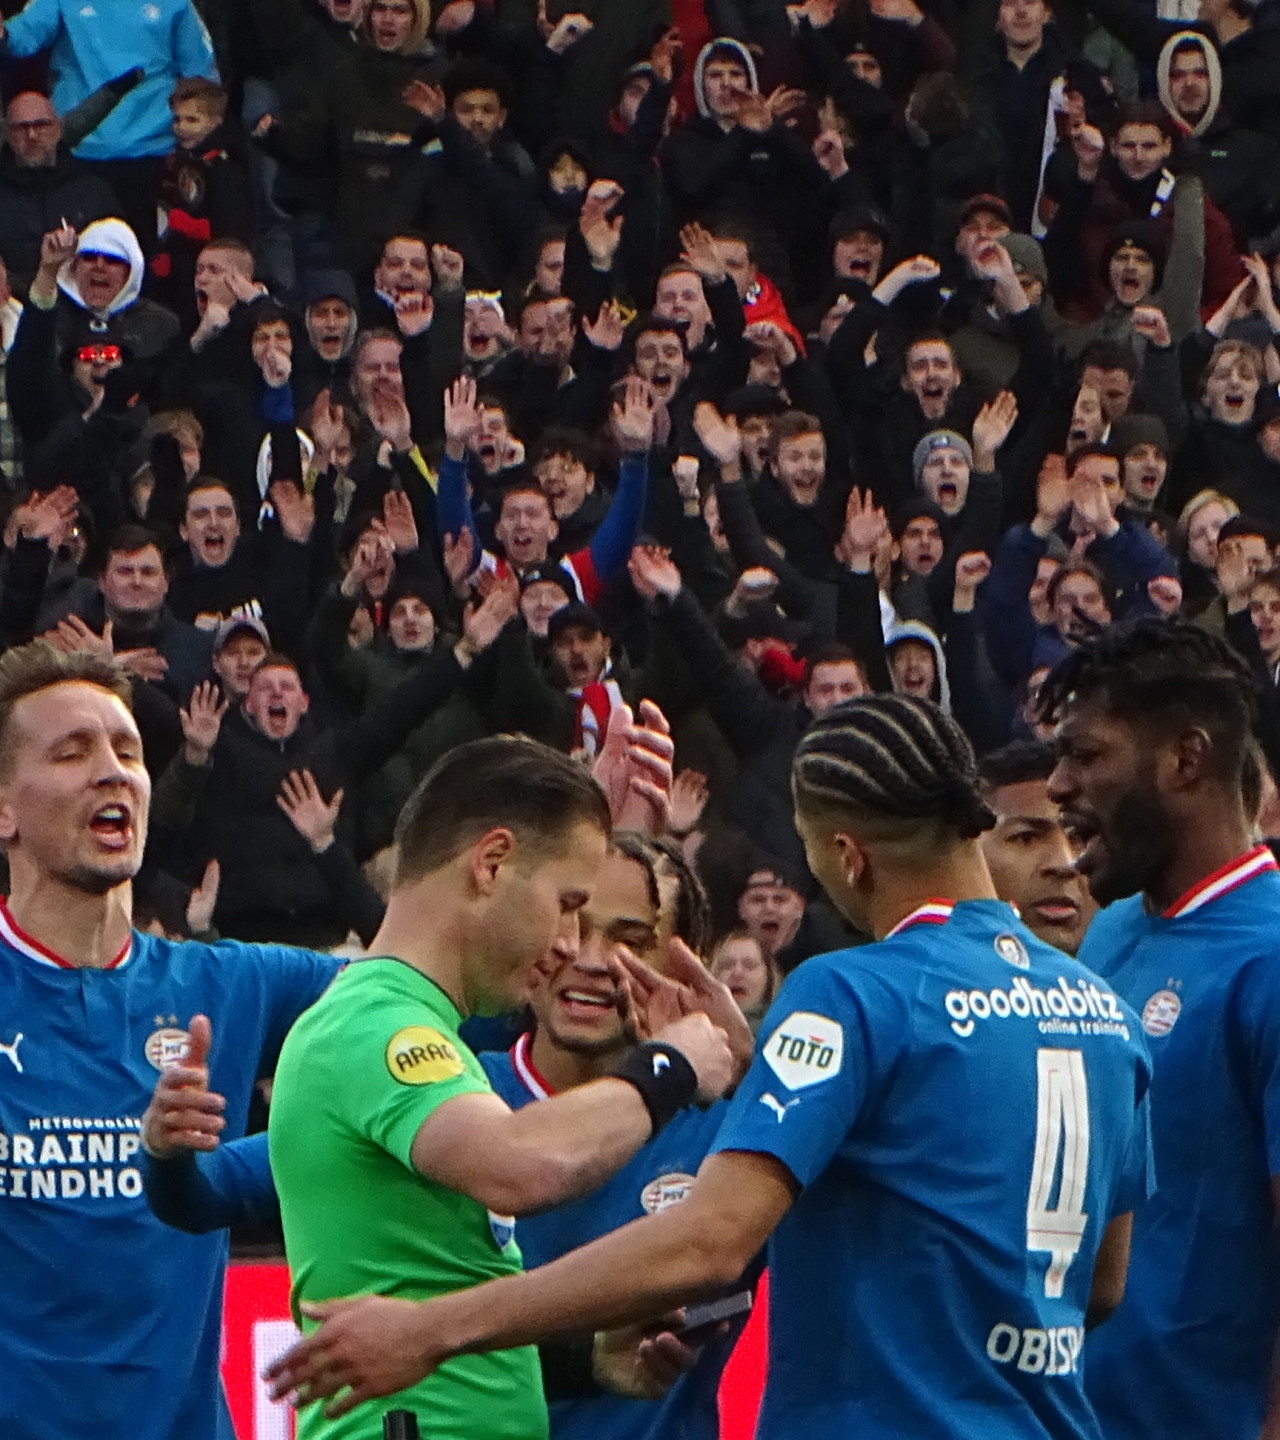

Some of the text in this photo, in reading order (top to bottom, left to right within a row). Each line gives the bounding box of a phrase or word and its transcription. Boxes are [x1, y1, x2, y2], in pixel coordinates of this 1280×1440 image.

[945, 976, 1124, 1037] goodhabitz
[1038, 1018, 1130, 1041] online training
[776, 1033, 835, 1070] TOTO
[1027, 1048, 1091, 1299] 4
[986, 1322, 1085, 1376] OBISP
